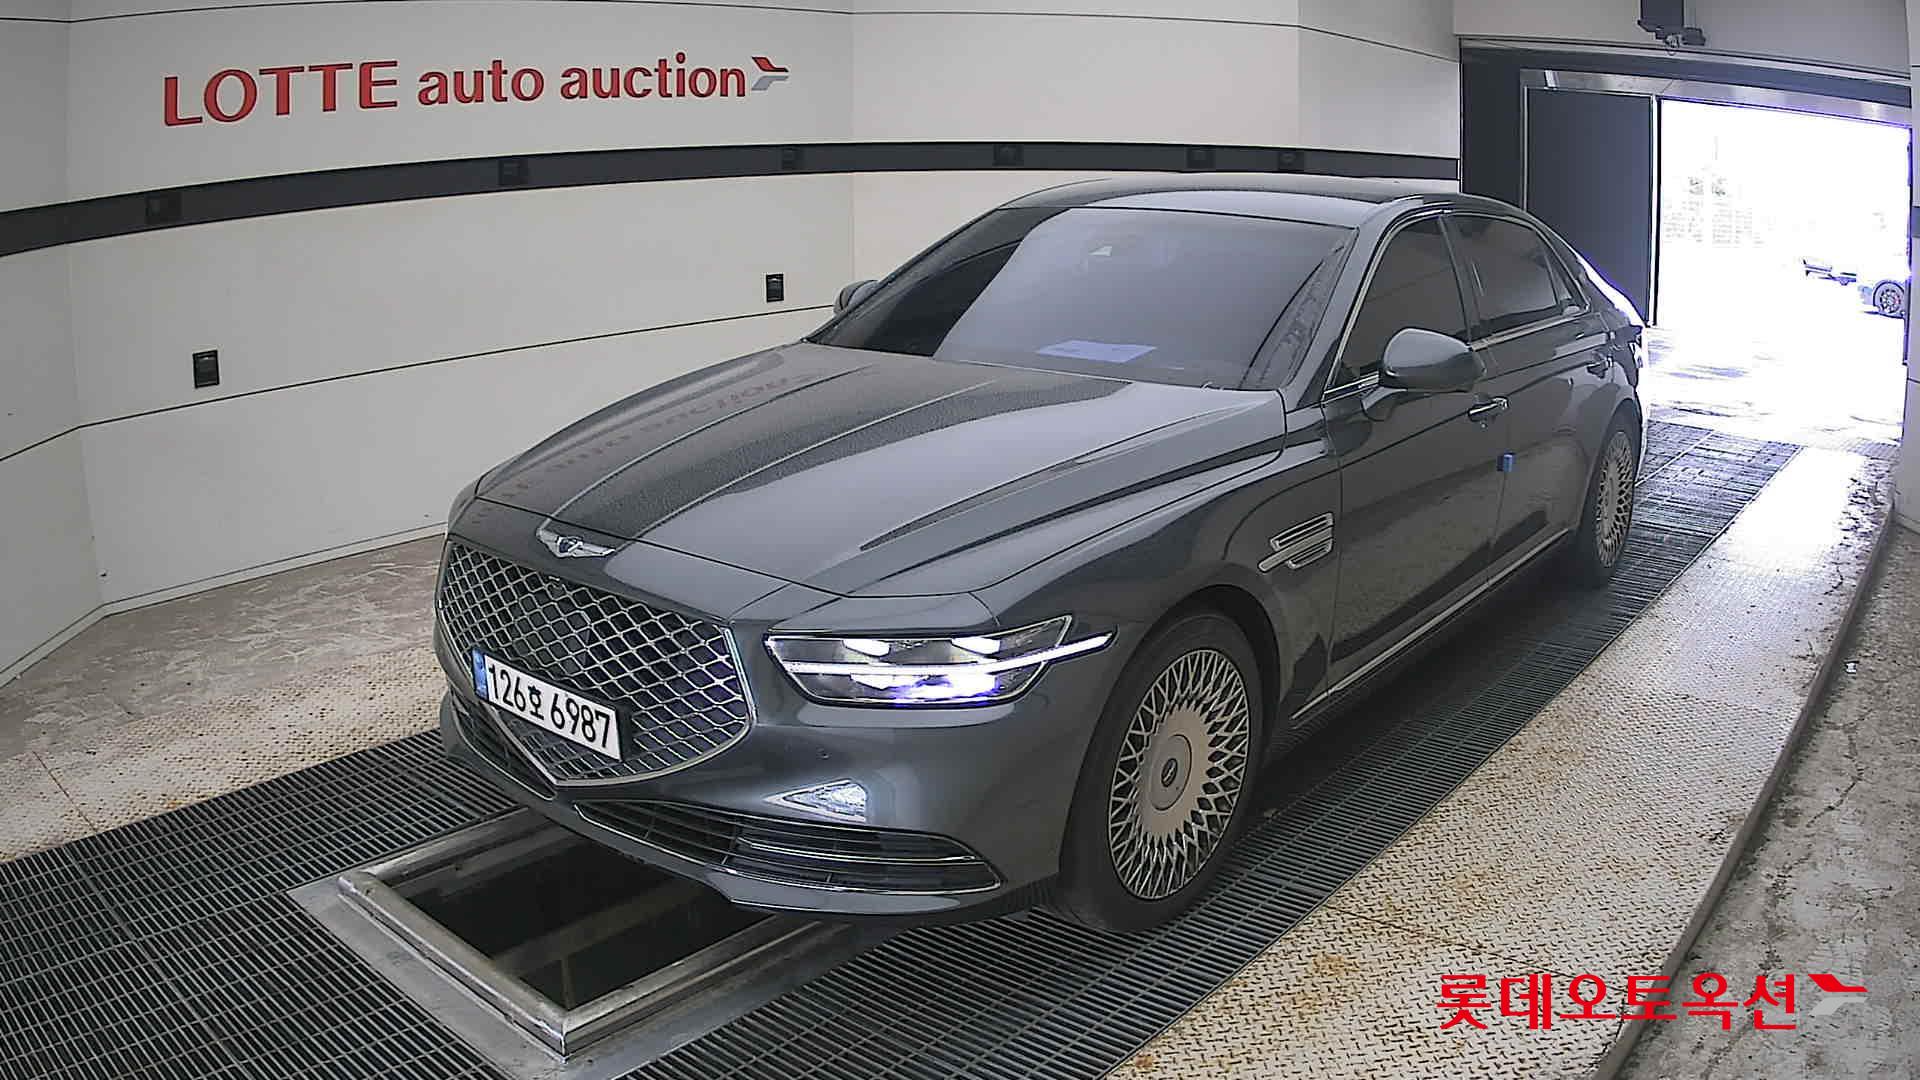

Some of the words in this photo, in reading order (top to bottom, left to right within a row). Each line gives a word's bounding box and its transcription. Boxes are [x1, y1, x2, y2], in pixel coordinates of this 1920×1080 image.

[164, 60, 398, 127] LOTTE
[417, 59, 545, 106] auto
[560, 52, 746, 100] auction
[551, 693, 610, 748] 6987
